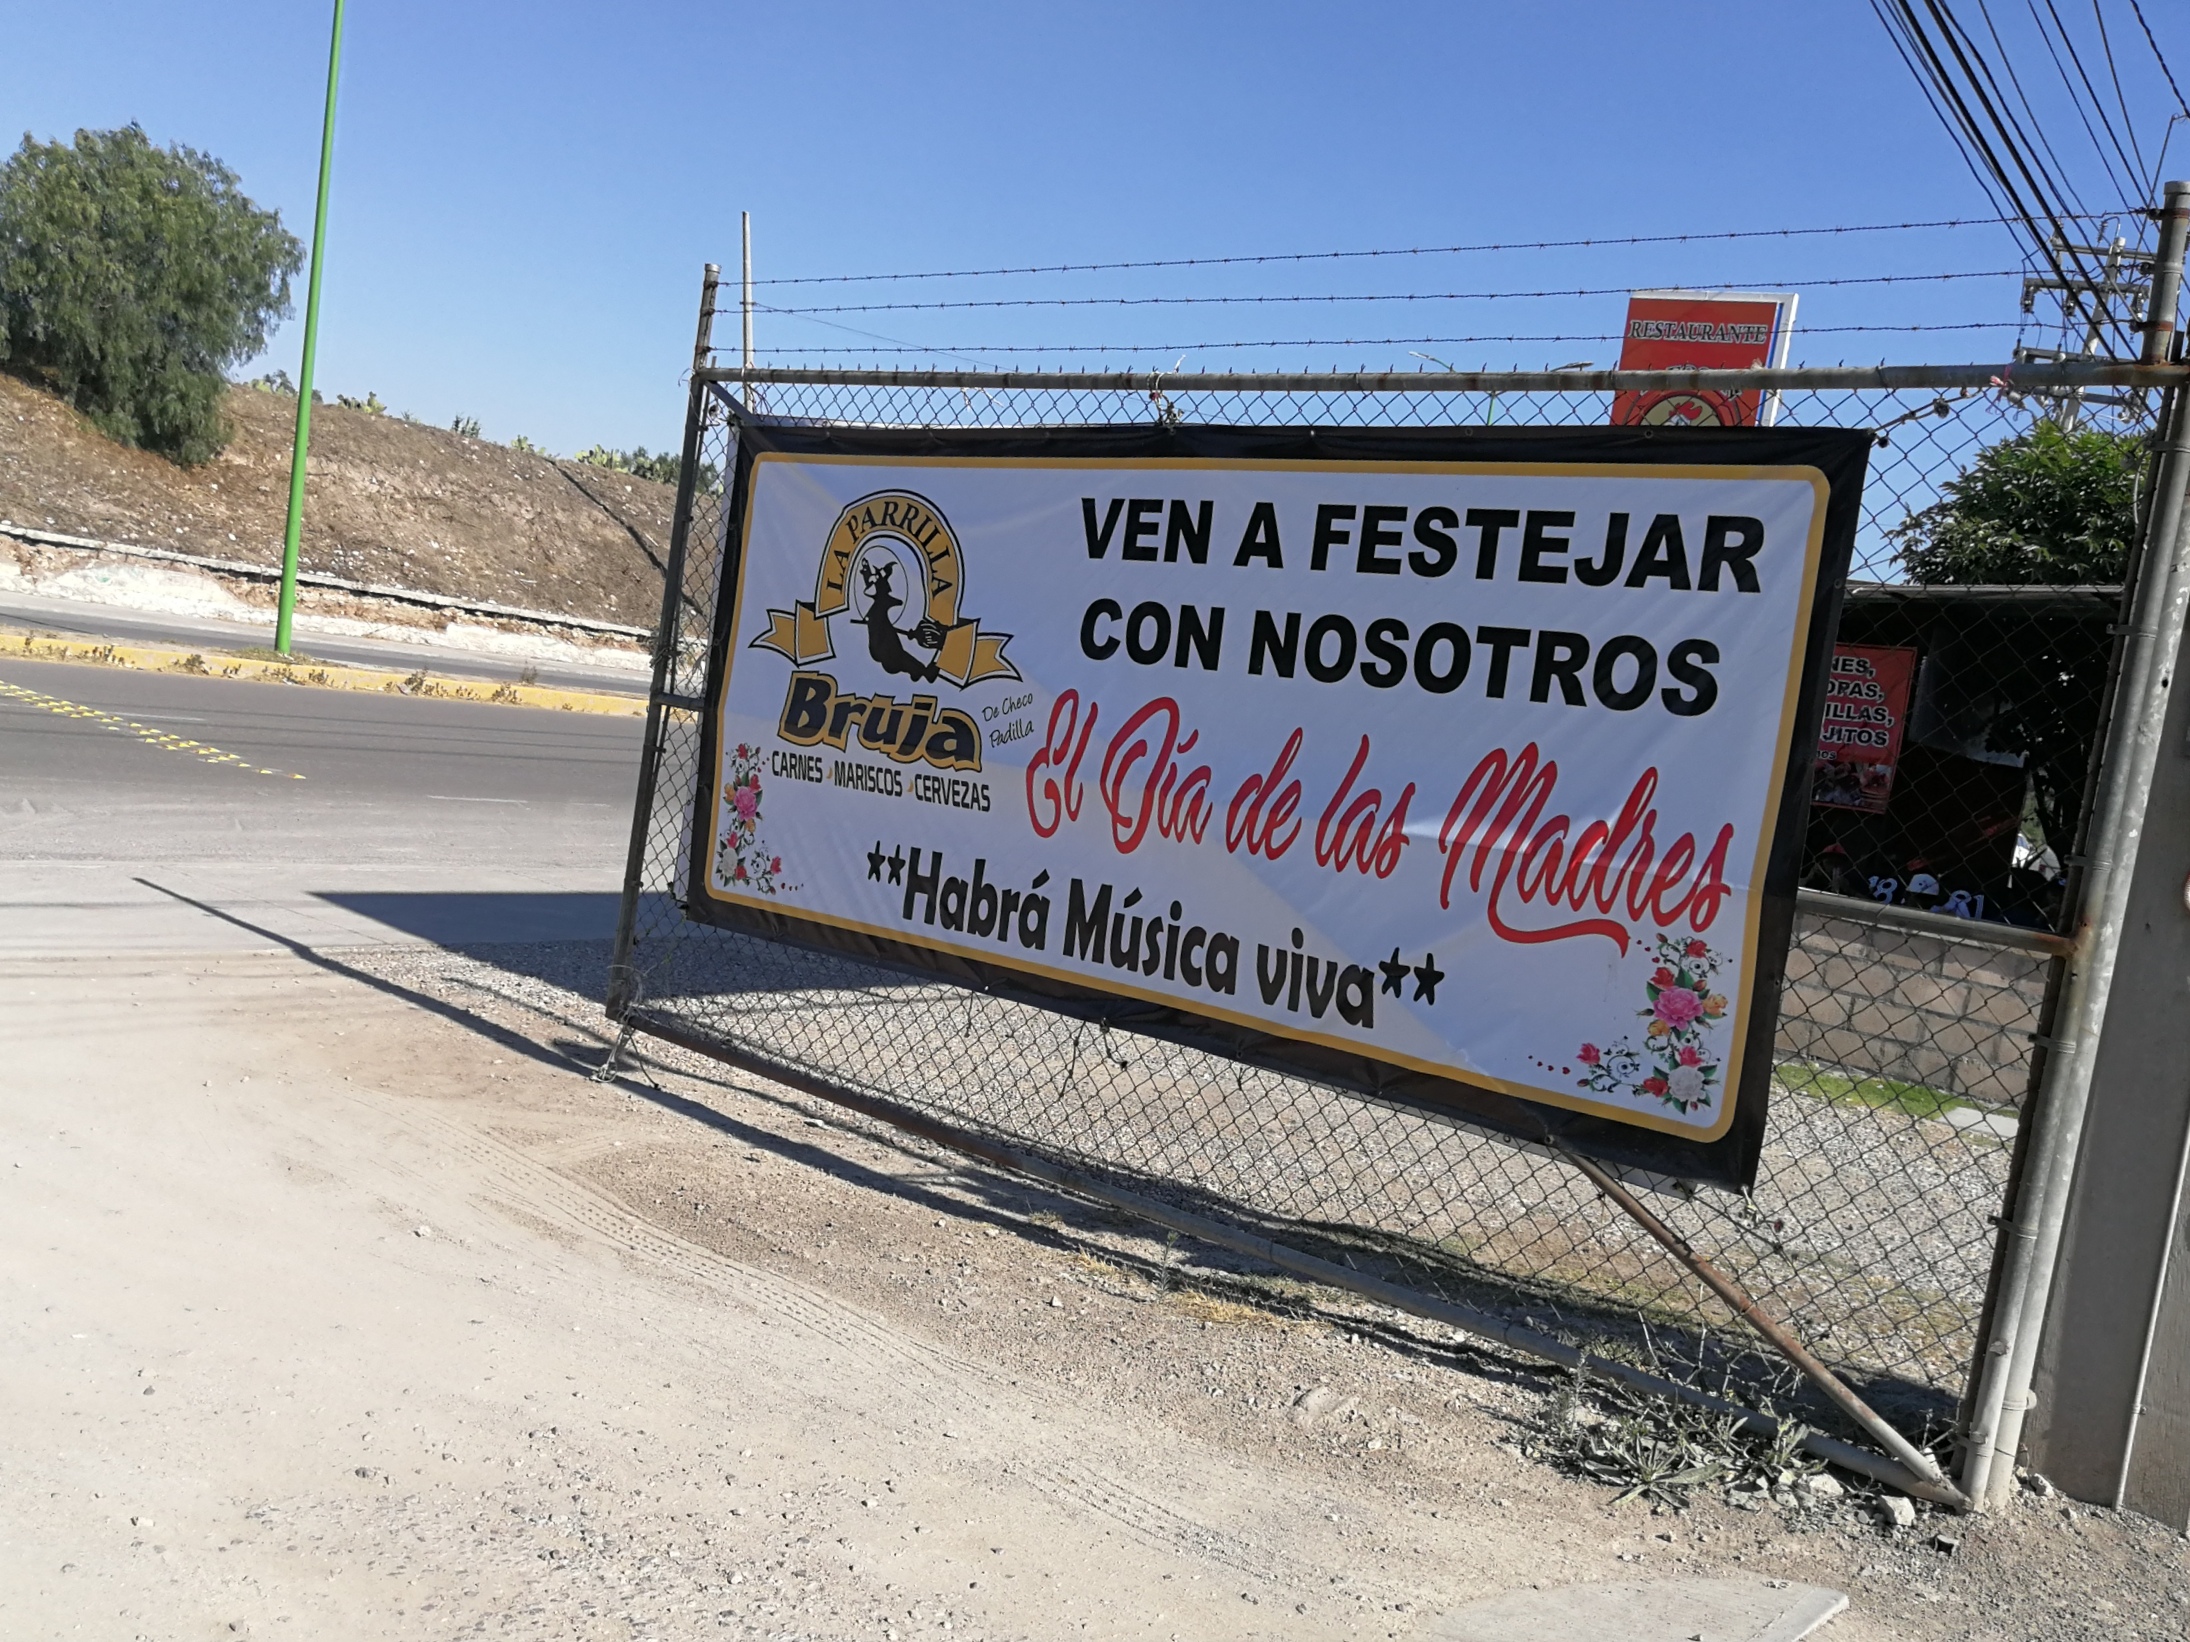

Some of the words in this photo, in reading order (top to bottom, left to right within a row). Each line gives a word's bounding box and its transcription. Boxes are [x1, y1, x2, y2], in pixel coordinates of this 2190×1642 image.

[1630, 320, 1768, 343] RESTAURANTE
[826, 550, 850, 594] LA
[846, 501, 953, 600] PARRILLA
[1081, 498, 1214, 564] VEN
[1233, 502, 1283, 569] A
[1310, 503, 1764, 593] FESTEJAR
[1080, 598, 1225, 671] CON
[1248, 610, 1720, 717] NOSOTROS
[777, 670, 982, 772] Bruja
[982, 706, 999, 722] De
[1002, 693, 1033, 713] Checo
[989, 719, 1034, 748] Padilla
[771, 751, 823, 783] CARNES
[834, 760, 903, 797] MARISCOS
[914, 773, 990, 812] CERVEZAS
[1026, 689, 1098, 839] El
[1100, 696, 1215, 855] Día
[1225, 727, 1303, 860] de
[1315, 734, 1416, 880] las
[1439, 742, 1734, 958] Madres
[1063, 877, 1240, 996] Música
